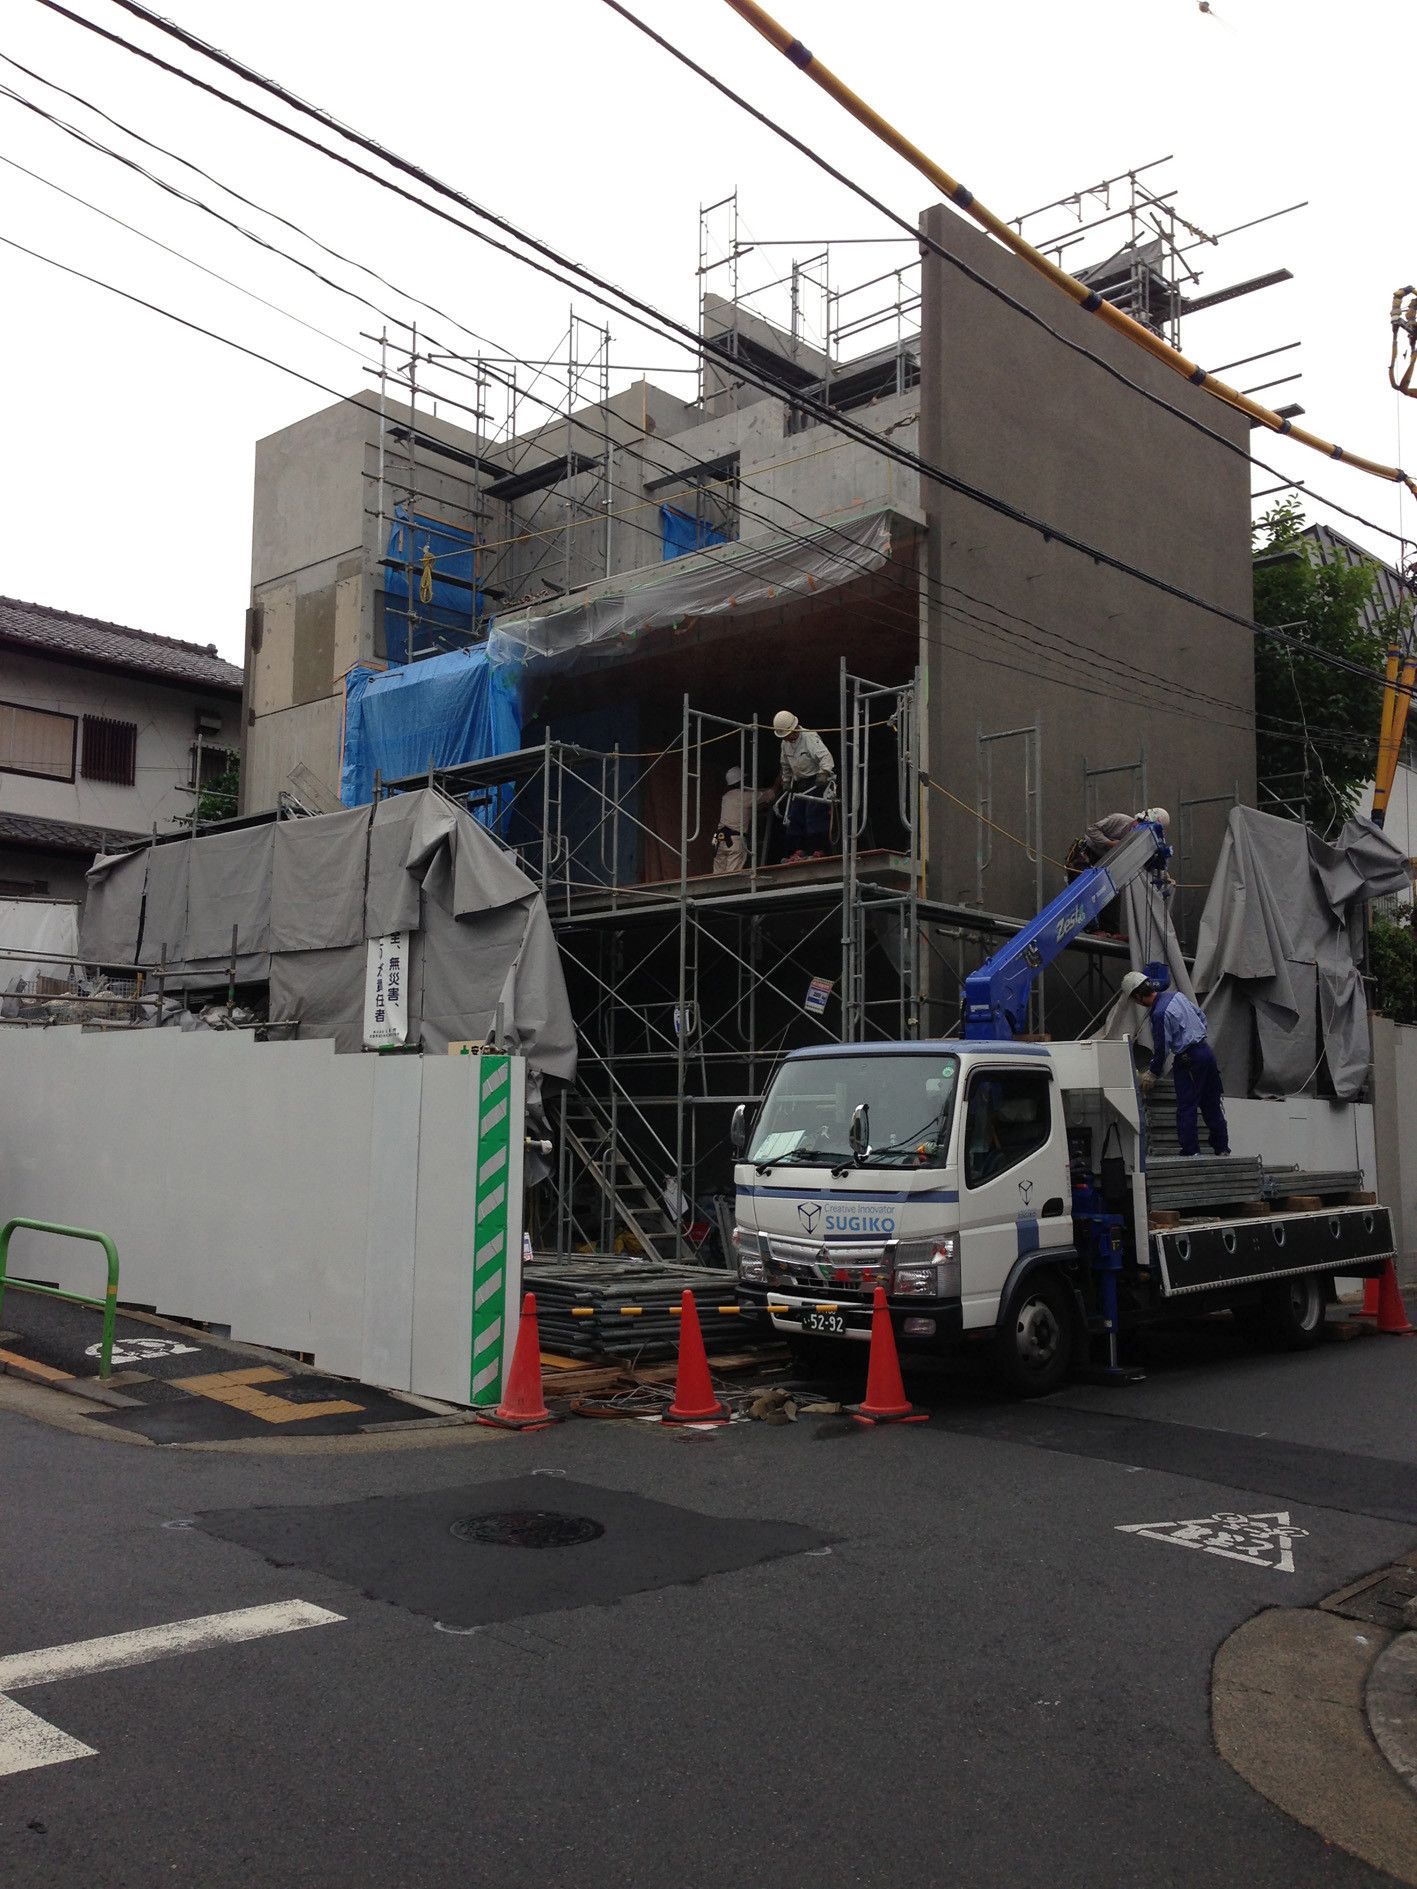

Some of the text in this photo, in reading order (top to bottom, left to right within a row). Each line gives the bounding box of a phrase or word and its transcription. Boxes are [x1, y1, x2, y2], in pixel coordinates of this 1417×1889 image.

[824, 1203, 856, 1214] Creative
[826, 1215, 895, 1233] SUGIKO
[810, 1313, 844, 1333] 52-92
